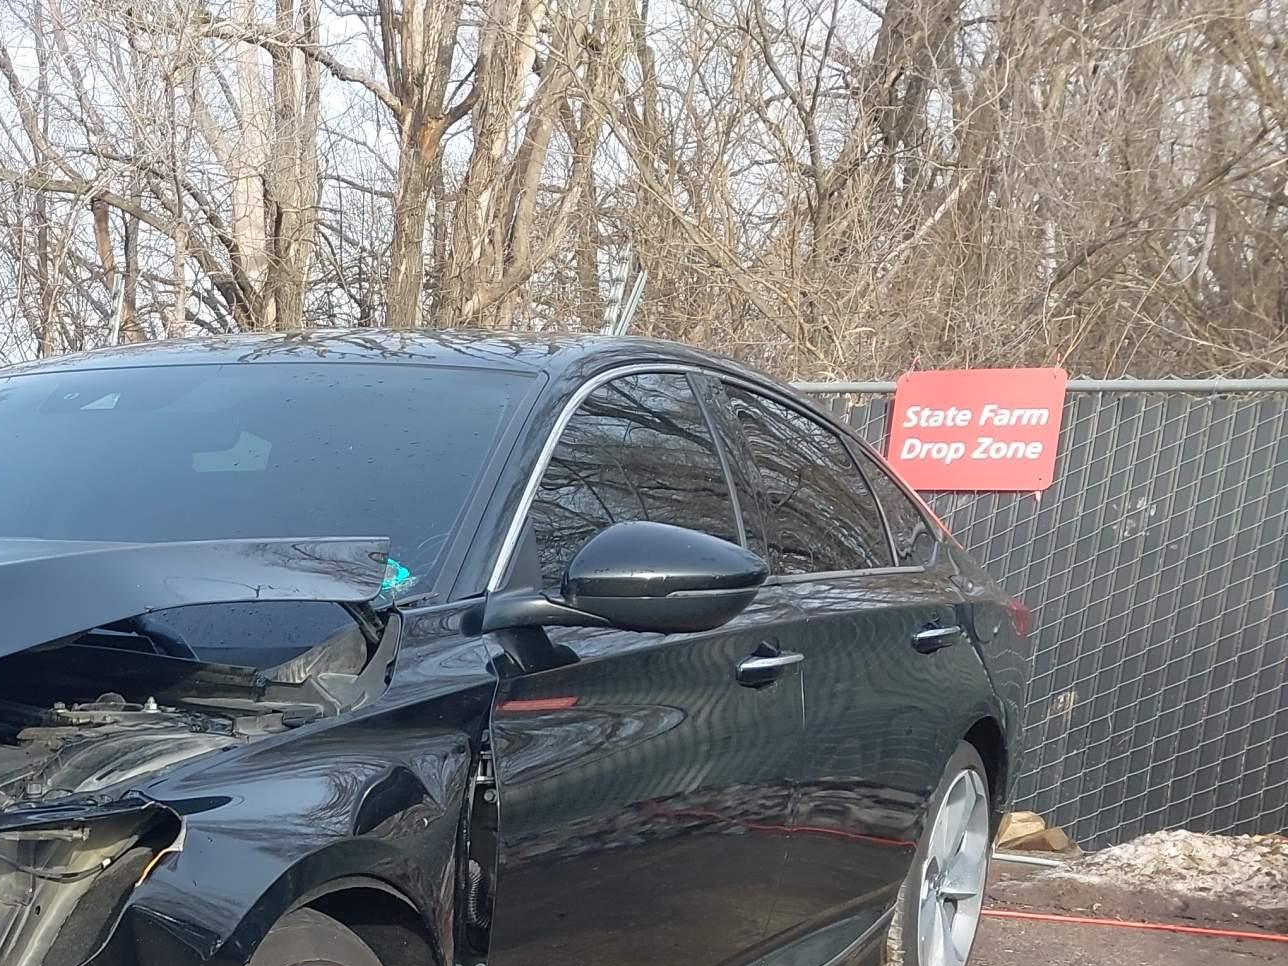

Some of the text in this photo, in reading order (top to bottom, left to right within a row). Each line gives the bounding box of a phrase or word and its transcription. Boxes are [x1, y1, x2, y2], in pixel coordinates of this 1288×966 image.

[902, 403, 1050, 428] State Farm
[899, 436, 1044, 464] Drop Zone
